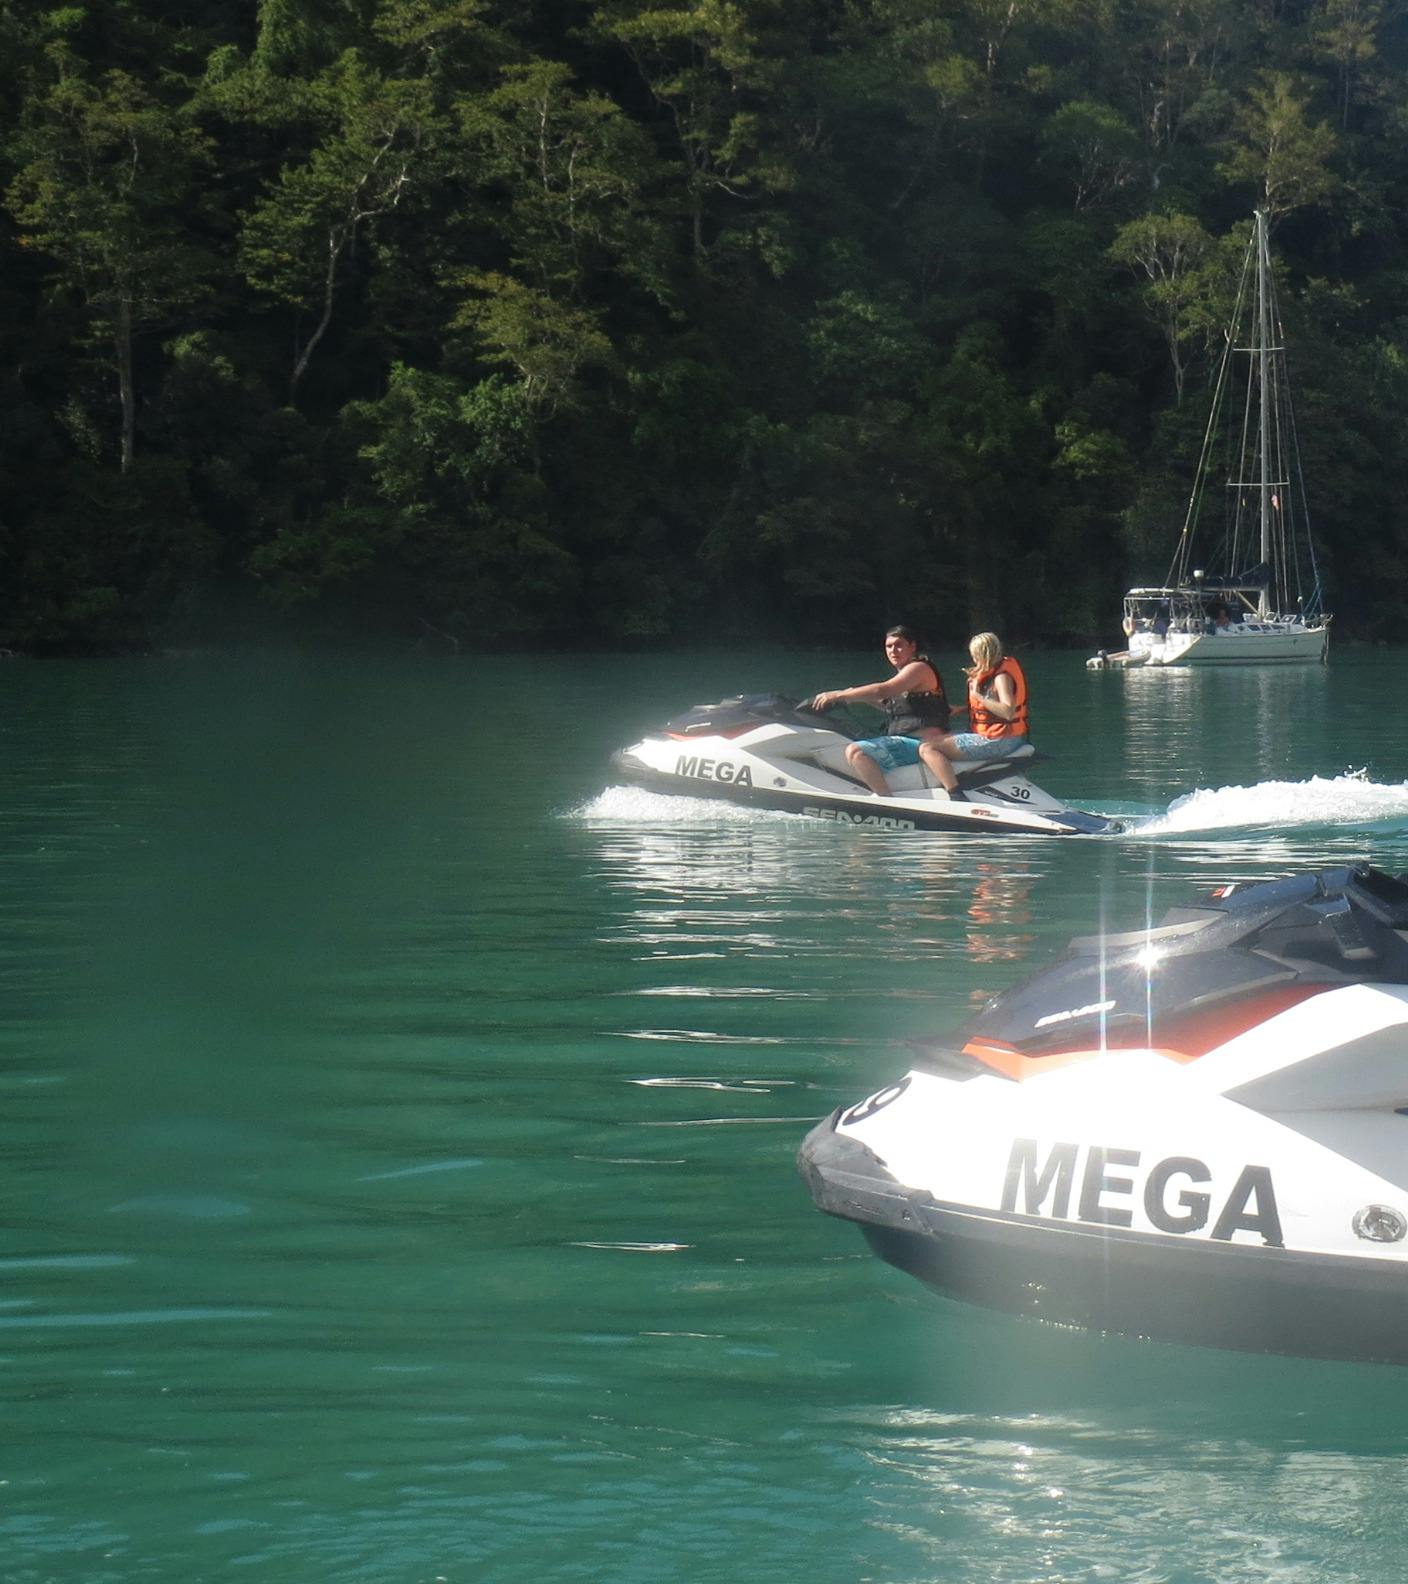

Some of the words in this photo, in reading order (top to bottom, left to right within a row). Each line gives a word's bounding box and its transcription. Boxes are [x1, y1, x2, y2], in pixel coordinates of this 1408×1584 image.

[675, 755, 753, 787] MEGA
[1010, 786, 1031, 800] 30
[1000, 1138, 1284, 1247] MEGA
